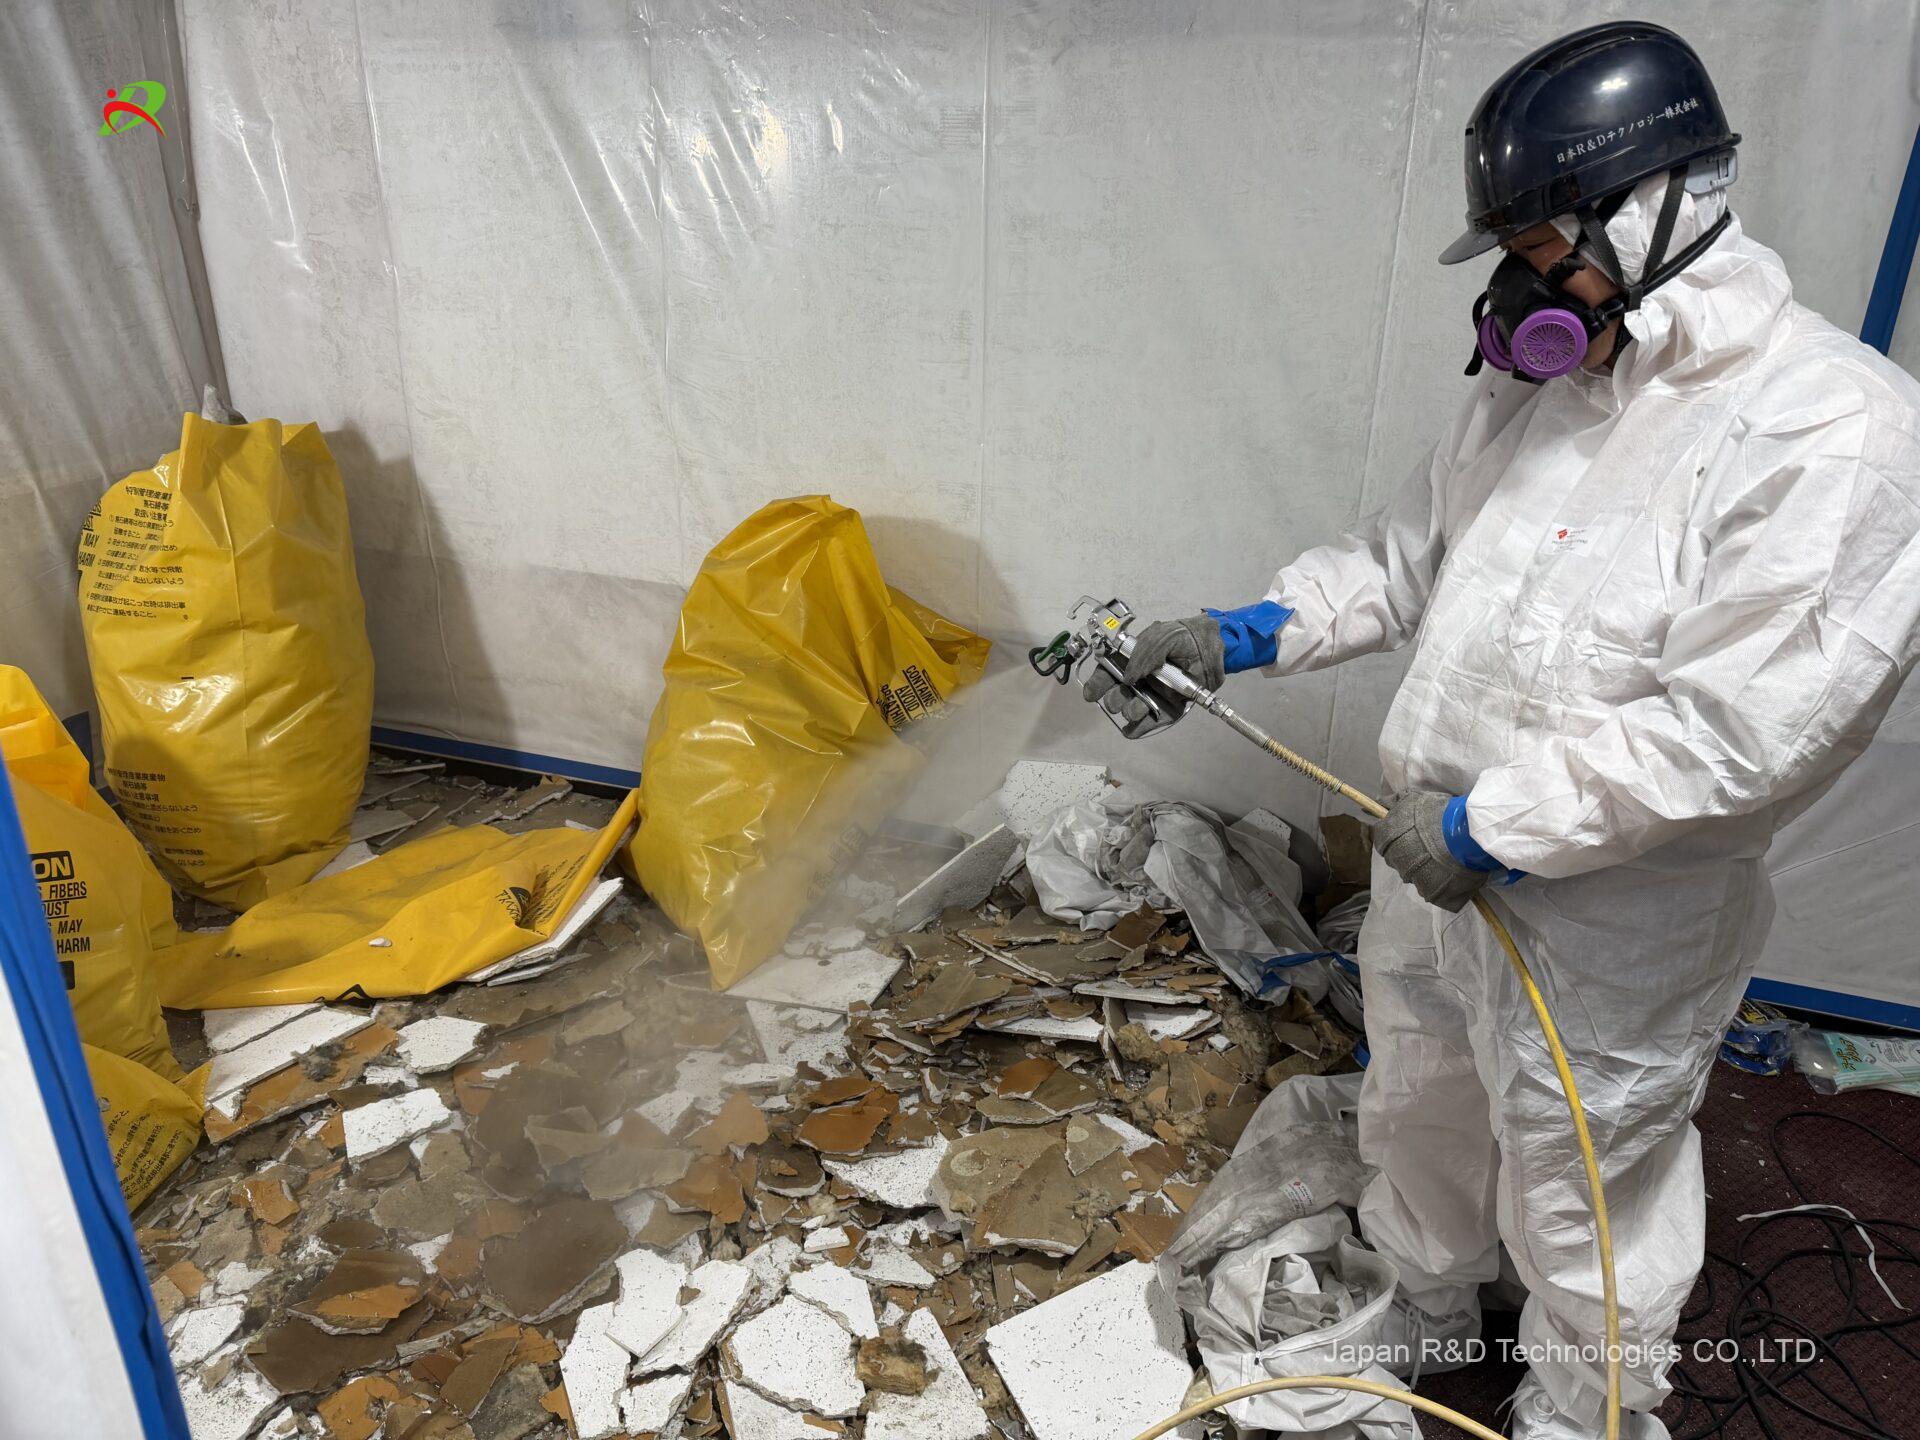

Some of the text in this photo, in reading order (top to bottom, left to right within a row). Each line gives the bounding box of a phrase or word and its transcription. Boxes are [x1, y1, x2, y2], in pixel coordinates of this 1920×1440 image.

[1557, 98, 1699, 163] 日本R&Dテクノロジー株式会社
[83, 533, 99, 548] MAY
[906, 665, 938, 707] CONTAINS
[896, 685, 920, 712] AVOID
[50, 881, 87, 899] FIBERS
[57, 919, 83, 934] MAY
[57, 937, 91, 954] HARM
